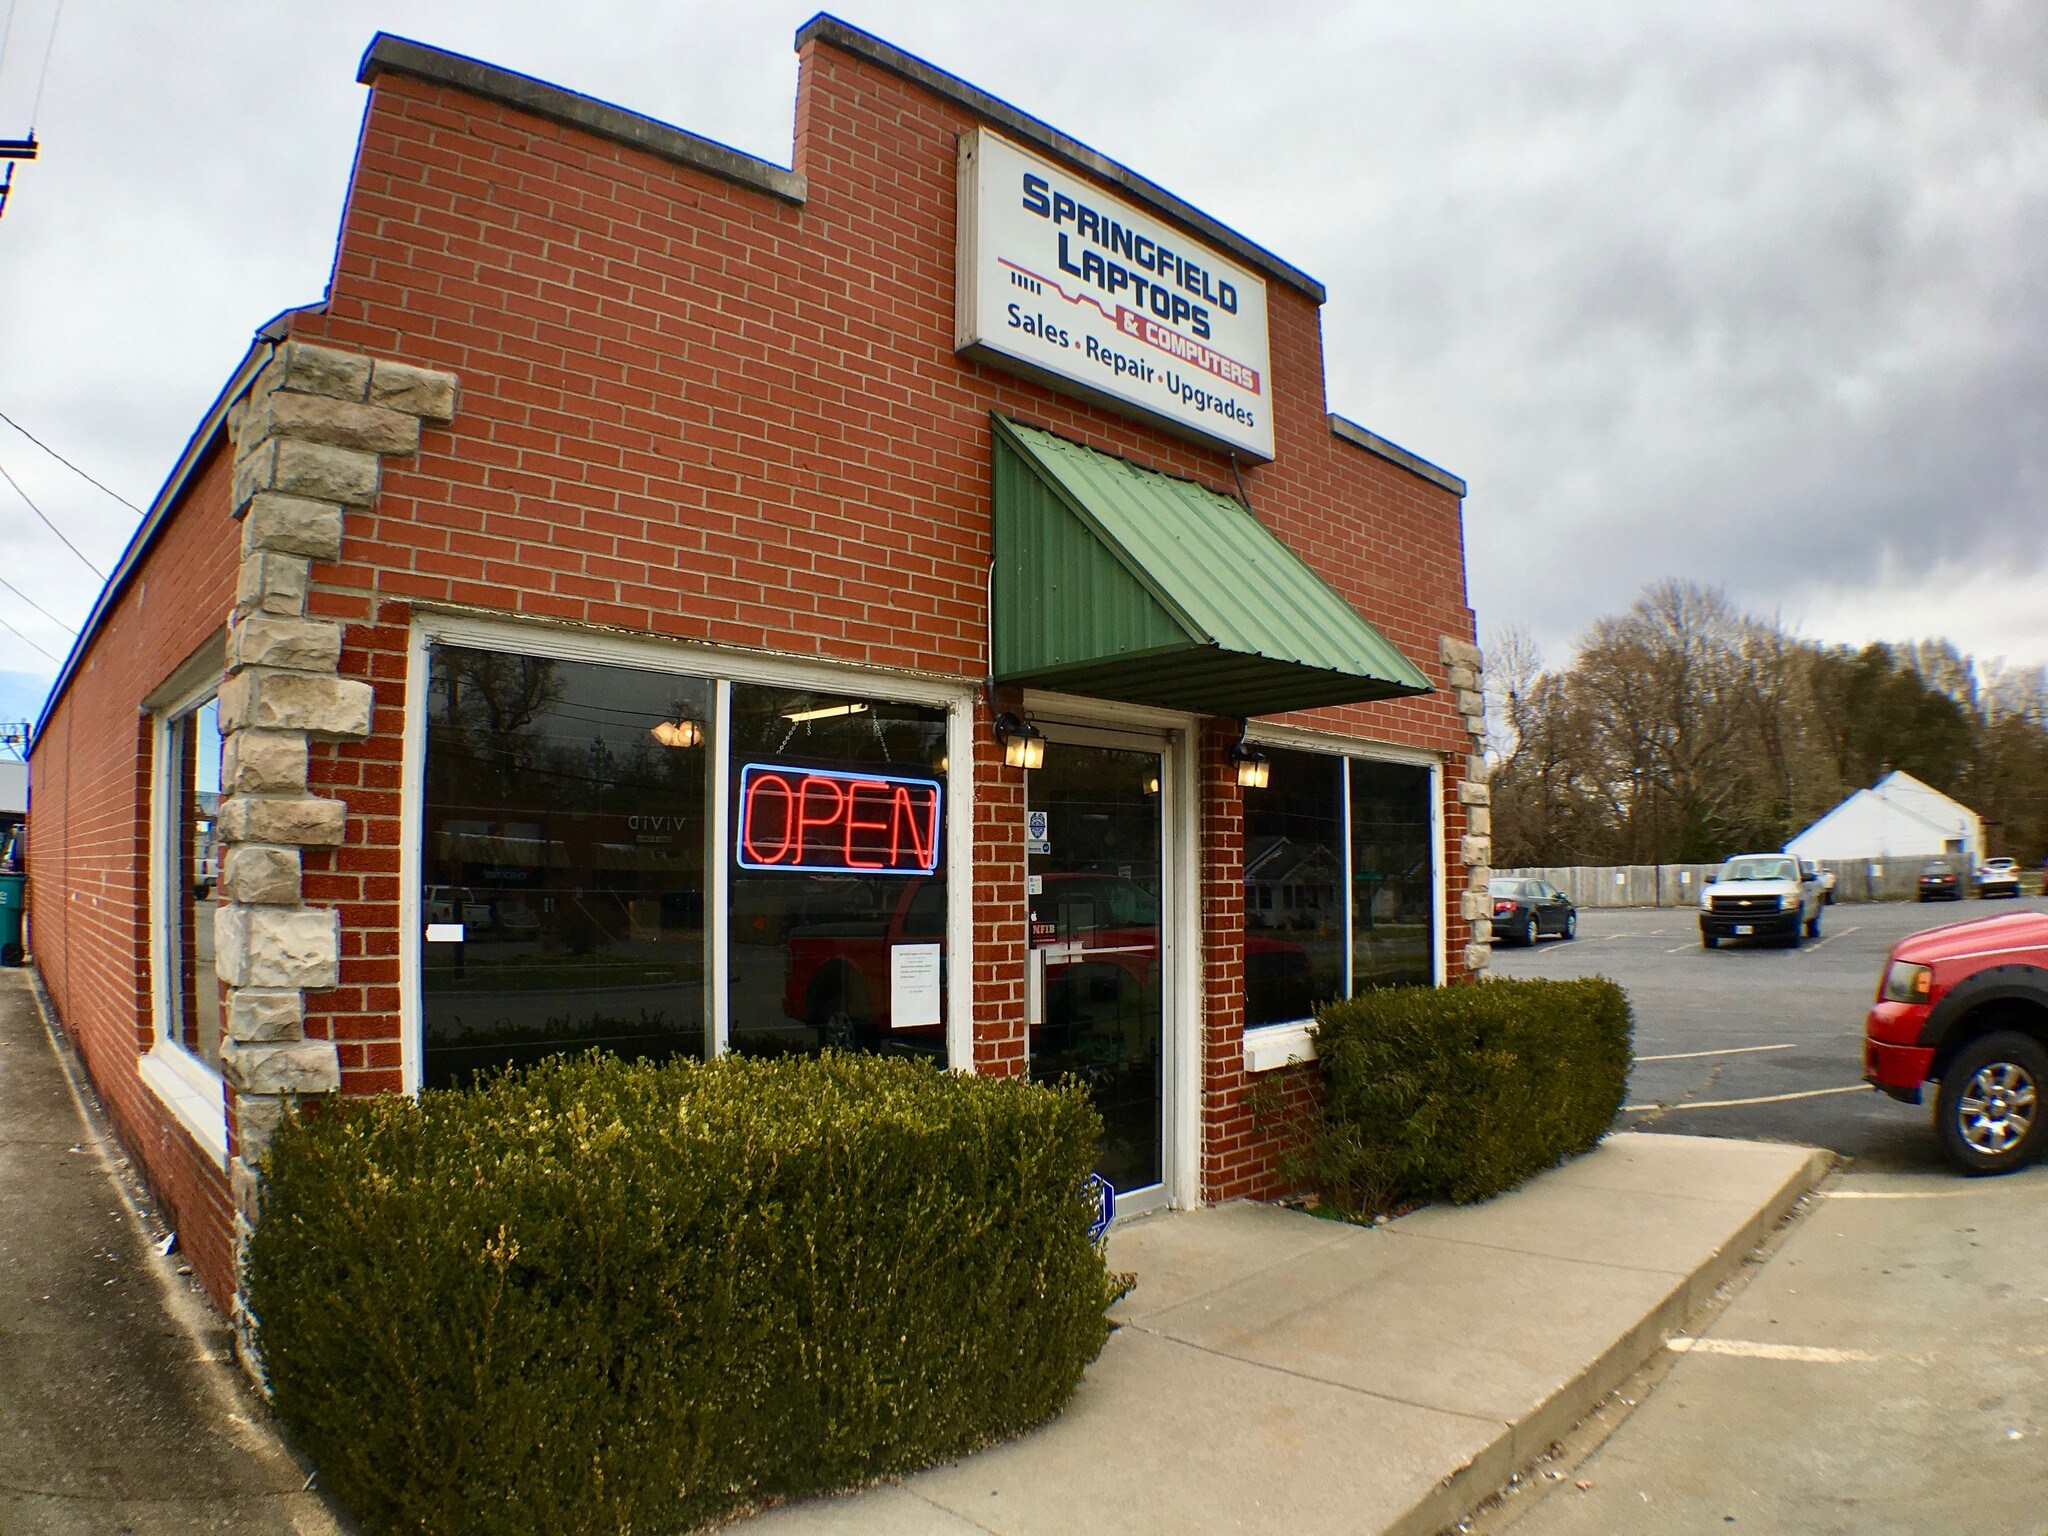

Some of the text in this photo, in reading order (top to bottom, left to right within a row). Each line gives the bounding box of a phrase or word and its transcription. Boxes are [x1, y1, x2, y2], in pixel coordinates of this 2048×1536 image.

[1022, 172, 1238, 315] SPRINGFIELD
[1057, 231, 1211, 340] LAPTOPS
[1007, 302, 1255, 428] Sales Repair Upgrades
[1123, 311, 1254, 390] & COMPUTERS
[743, 773, 936, 870] OPEN
[1032, 924, 1055, 934] NFIB
